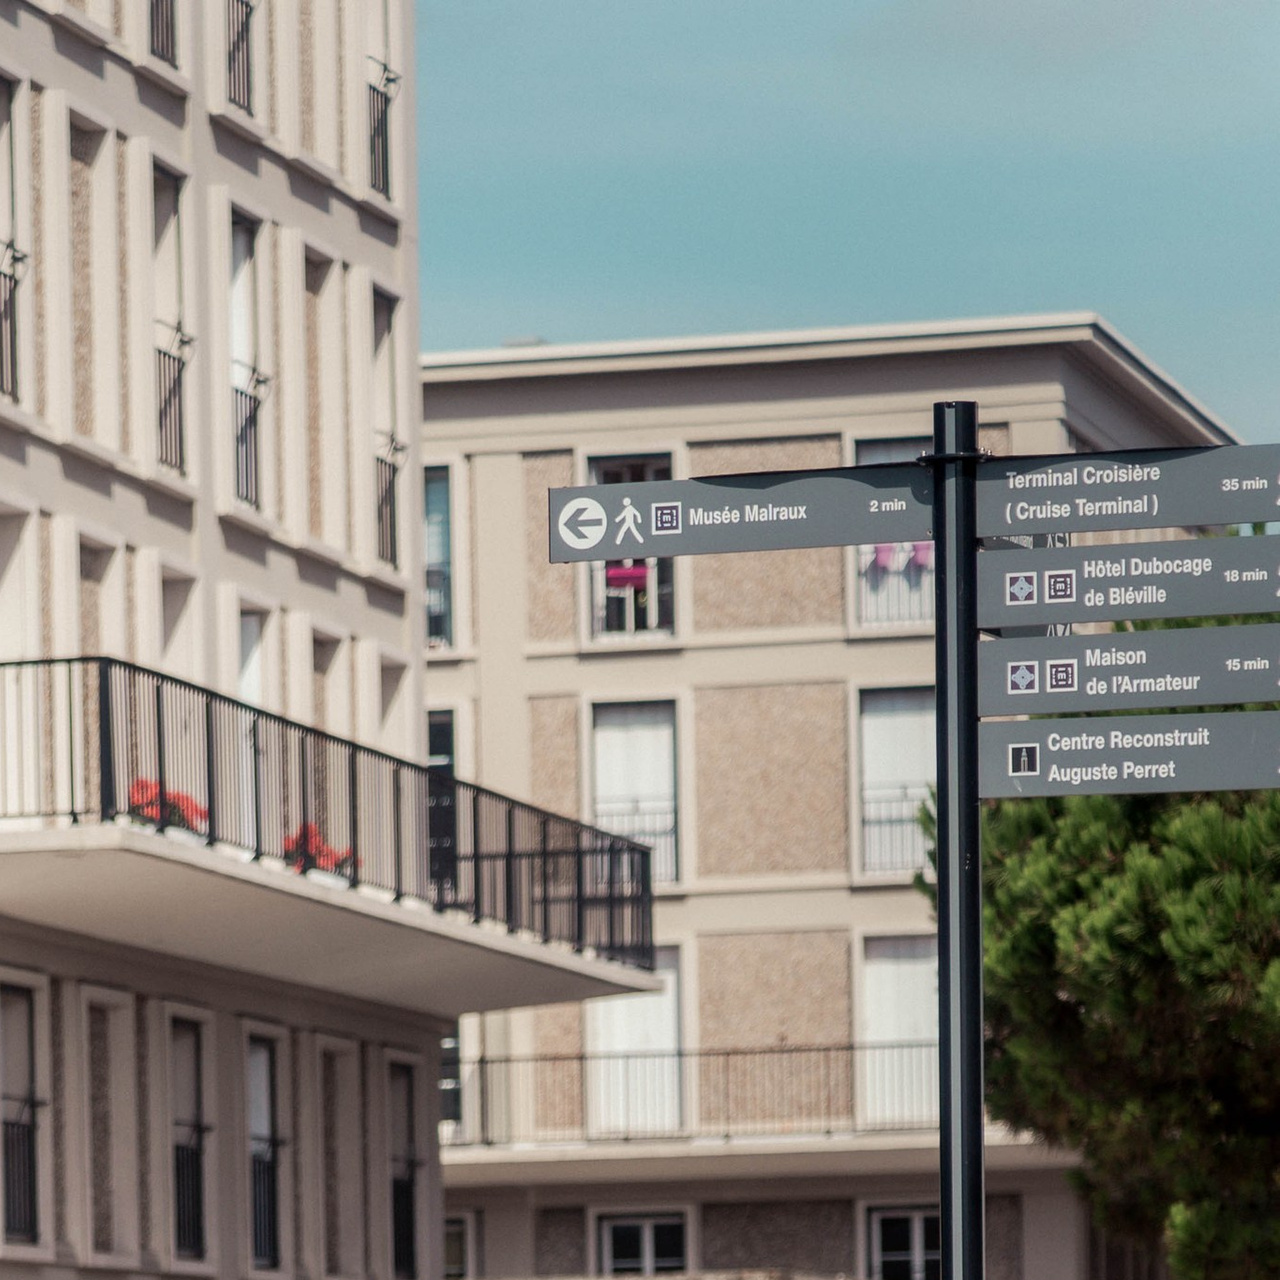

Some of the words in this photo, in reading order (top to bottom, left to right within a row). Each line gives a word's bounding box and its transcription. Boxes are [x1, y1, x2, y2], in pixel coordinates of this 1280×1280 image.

[1006, 467, 1078, 489] Terminal
[1082, 463, 1161, 485] Croisière
[1222, 478, 1239, 491] 35
[1242, 477, 1268, 490] min
[689, 506, 741, 526] Musée
[744, 504, 807, 521] Malraux
[869, 501, 879, 513] 2
[881, 499, 907, 511] min
[1016, 500, 1071, 520] Cruise
[1076, 495, 1148, 516] Terminal
[1084, 558, 1126, 578] Hôtel
[1130, 556, 1213, 577] Dubocage
[1224, 570, 1239, 582] 18
[1242, 568, 1268, 581] min
[1084, 590, 1105, 607] de
[1109, 586, 1167, 605] Bléville
[1085, 647, 1147, 667] Maison
[1226, 659, 1240, 671] 15
[1244, 657, 1269, 670] min
[1086, 678, 1108, 695] de
[1048, 733, 1106, 751] Centre
[1110, 728, 1210, 748] Reconstruit
[1048, 763, 1118, 785] Auguste
[1122, 760, 1176, 779] Perret
